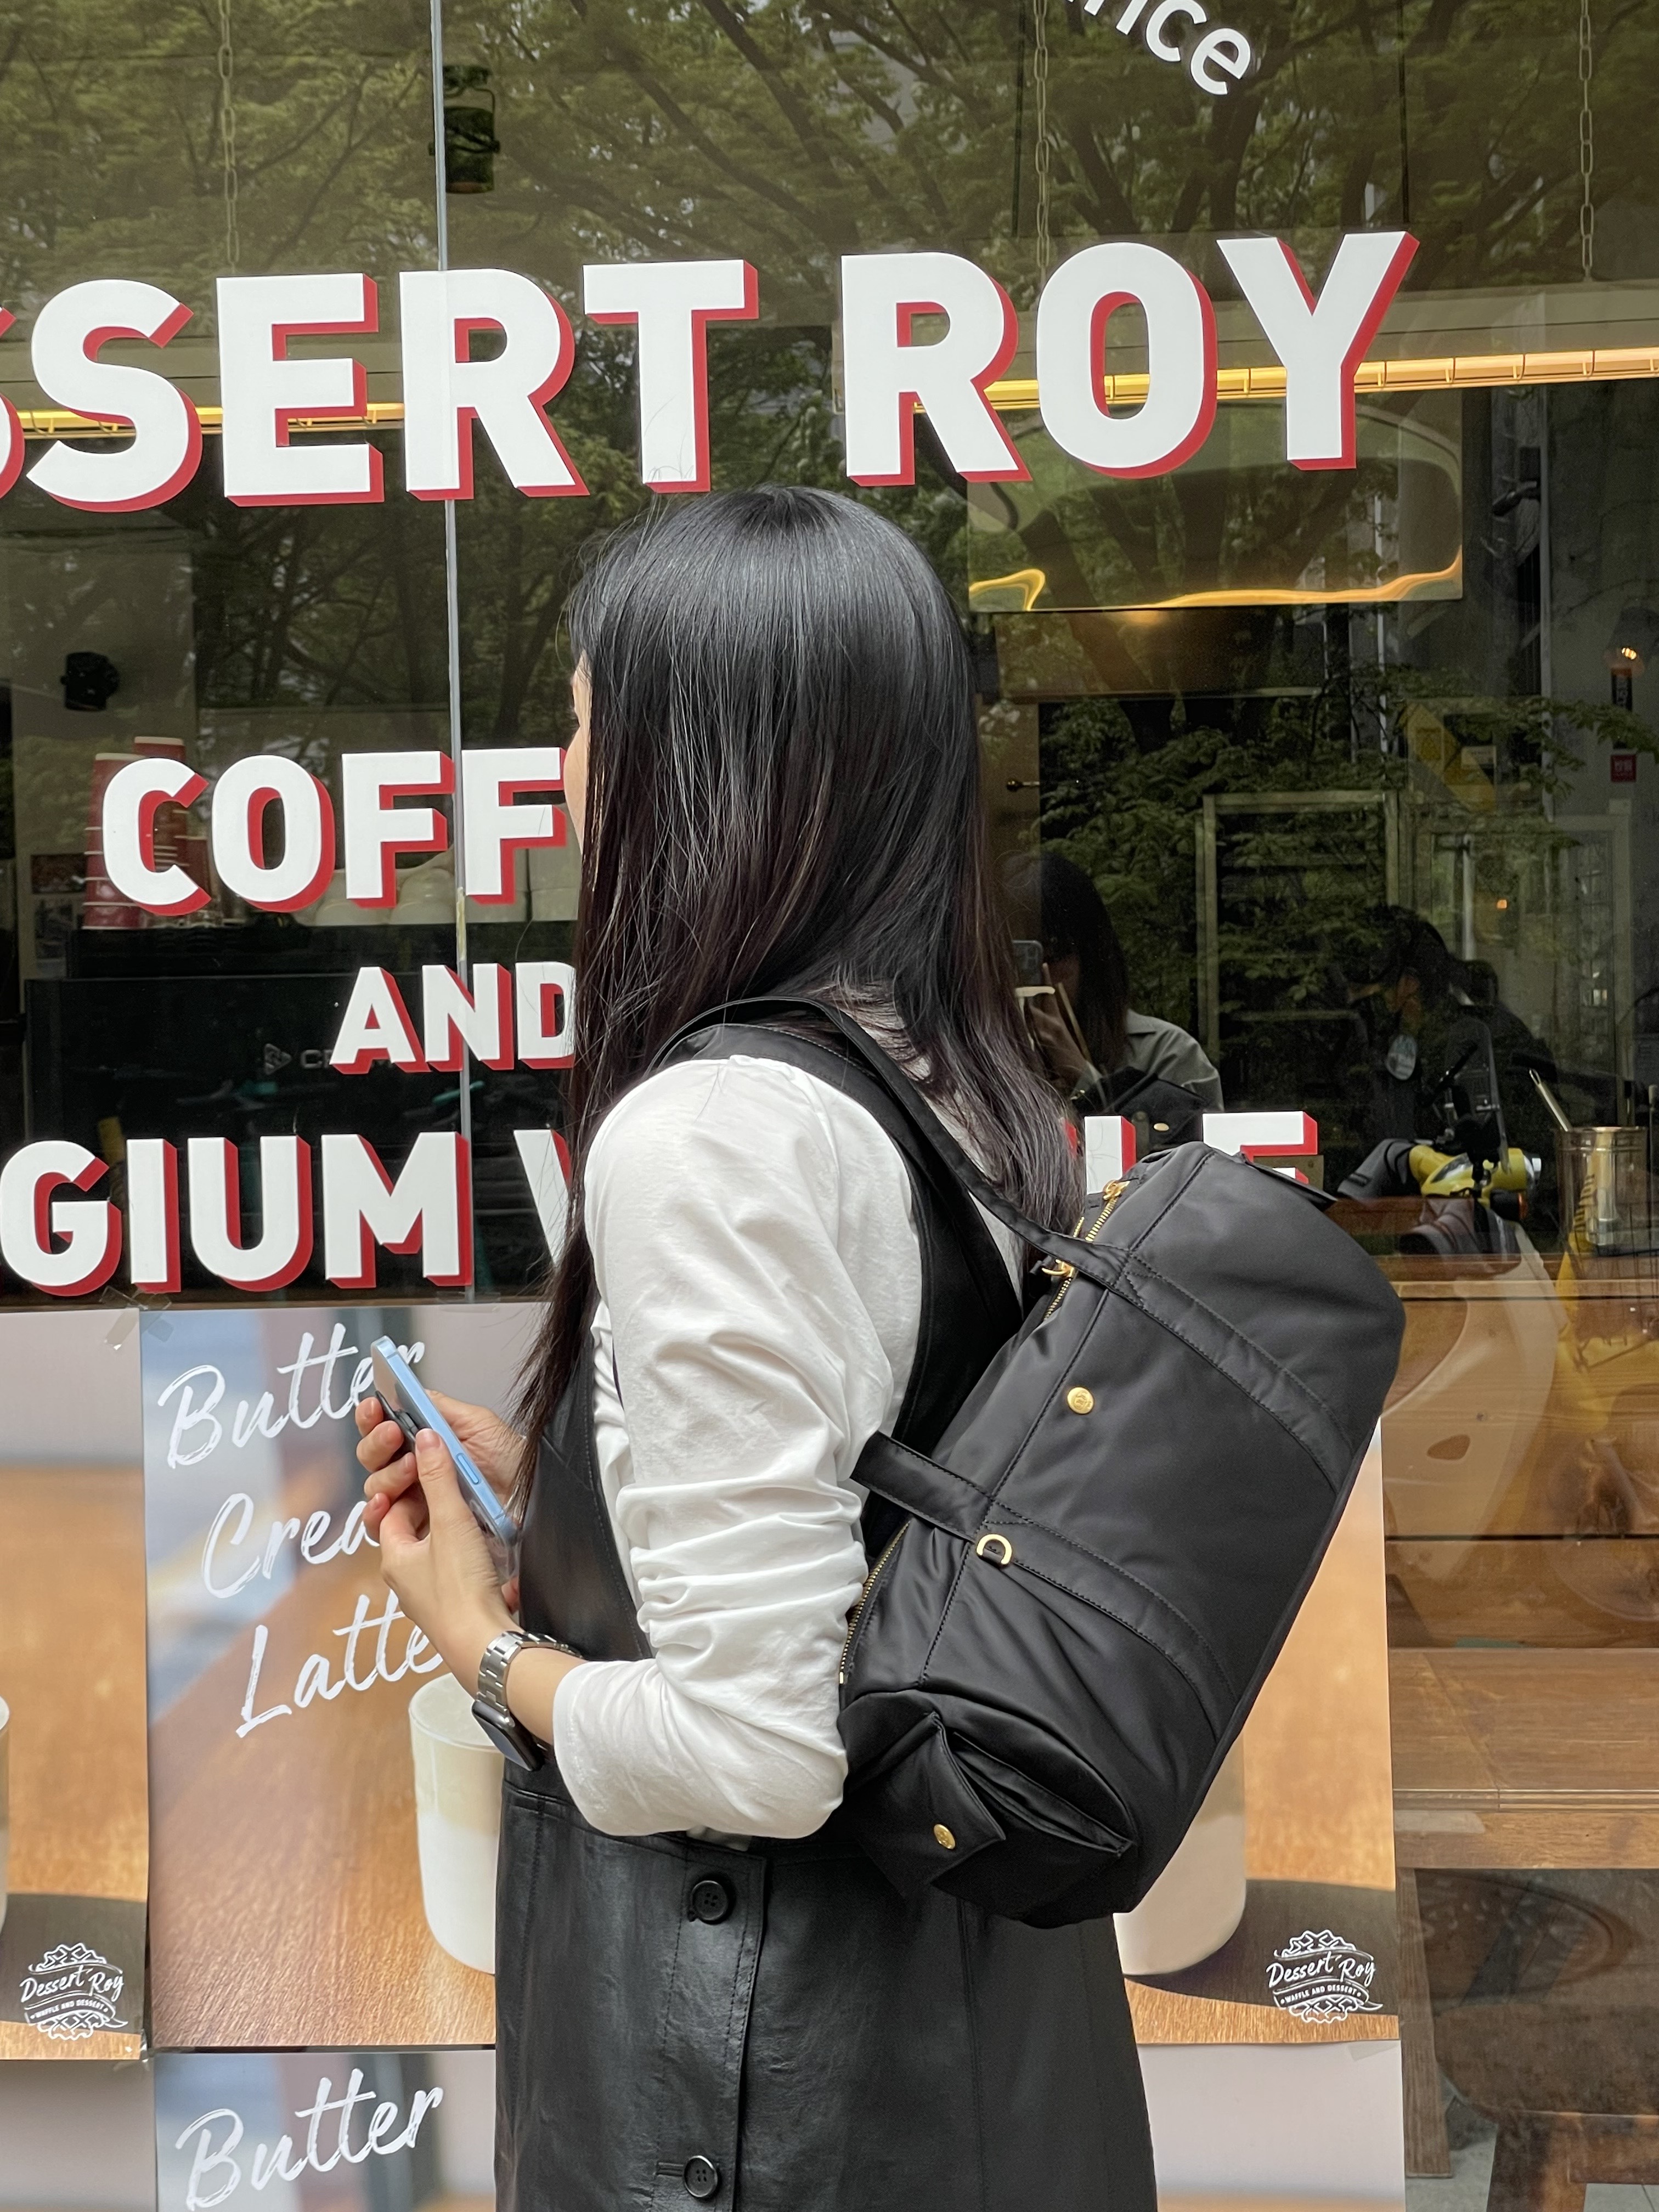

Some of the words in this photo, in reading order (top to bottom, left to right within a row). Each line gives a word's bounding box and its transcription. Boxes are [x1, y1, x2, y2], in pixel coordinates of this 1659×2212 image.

[0, 259, 758, 512] SERT
[841, 230, 1419, 486] ROY
[329, 962, 575, 1074] AND
[0, 1131, 472, 1296] GIUM
[235, 1589, 443, 1738] Latte
[19, 1965, 93, 2002] Dessert
[88, 1972, 124, 2002] Roy
[1266, 1951, 1342, 1988] Dessert
[1339, 1958, 1375, 1987] Roy
[1284, 1990, 1310, 2003] WAFFLE
[1312, 1987, 1325, 1995] AND
[1327, 1984, 1357, 1996] DESSERT
[176, 2068, 443, 2211] Butter
